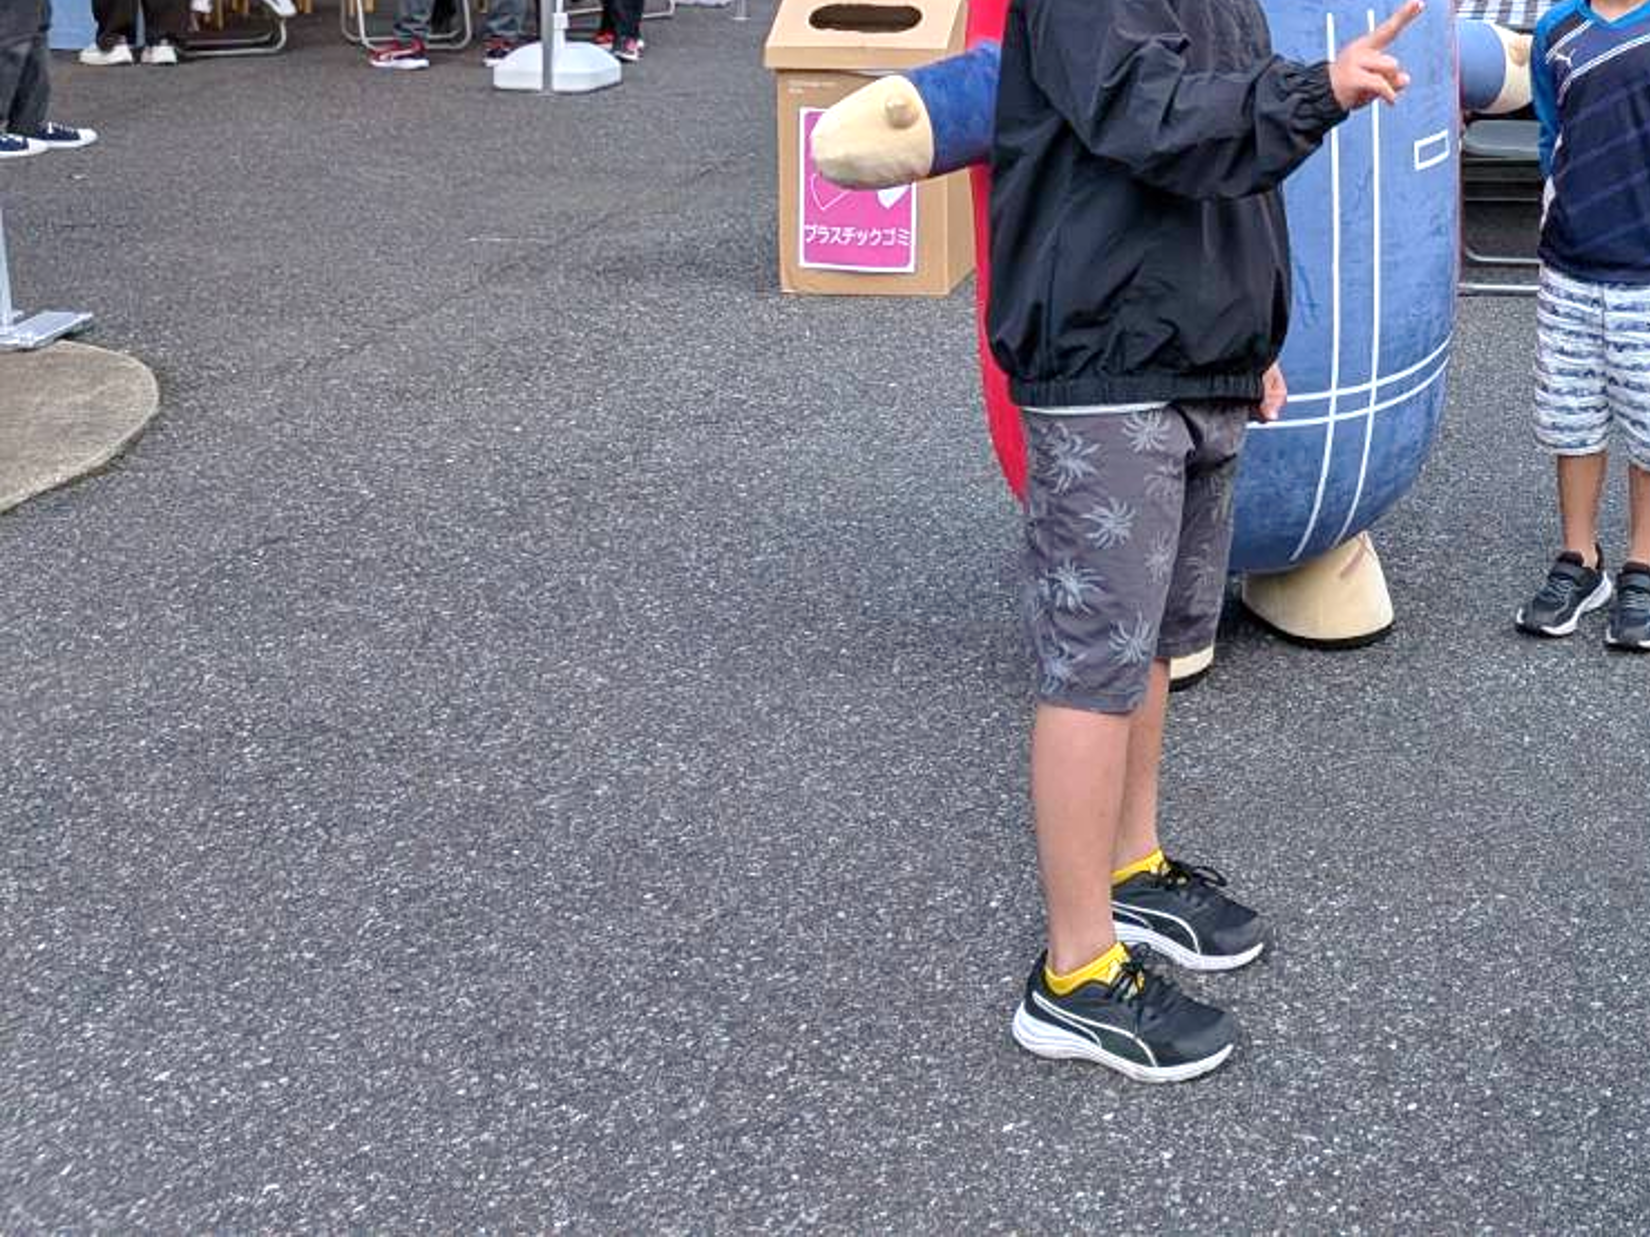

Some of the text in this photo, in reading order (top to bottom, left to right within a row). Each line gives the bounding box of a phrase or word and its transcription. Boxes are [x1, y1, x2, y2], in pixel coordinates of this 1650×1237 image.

[803, 223, 911, 247] プラスチックゴミ
